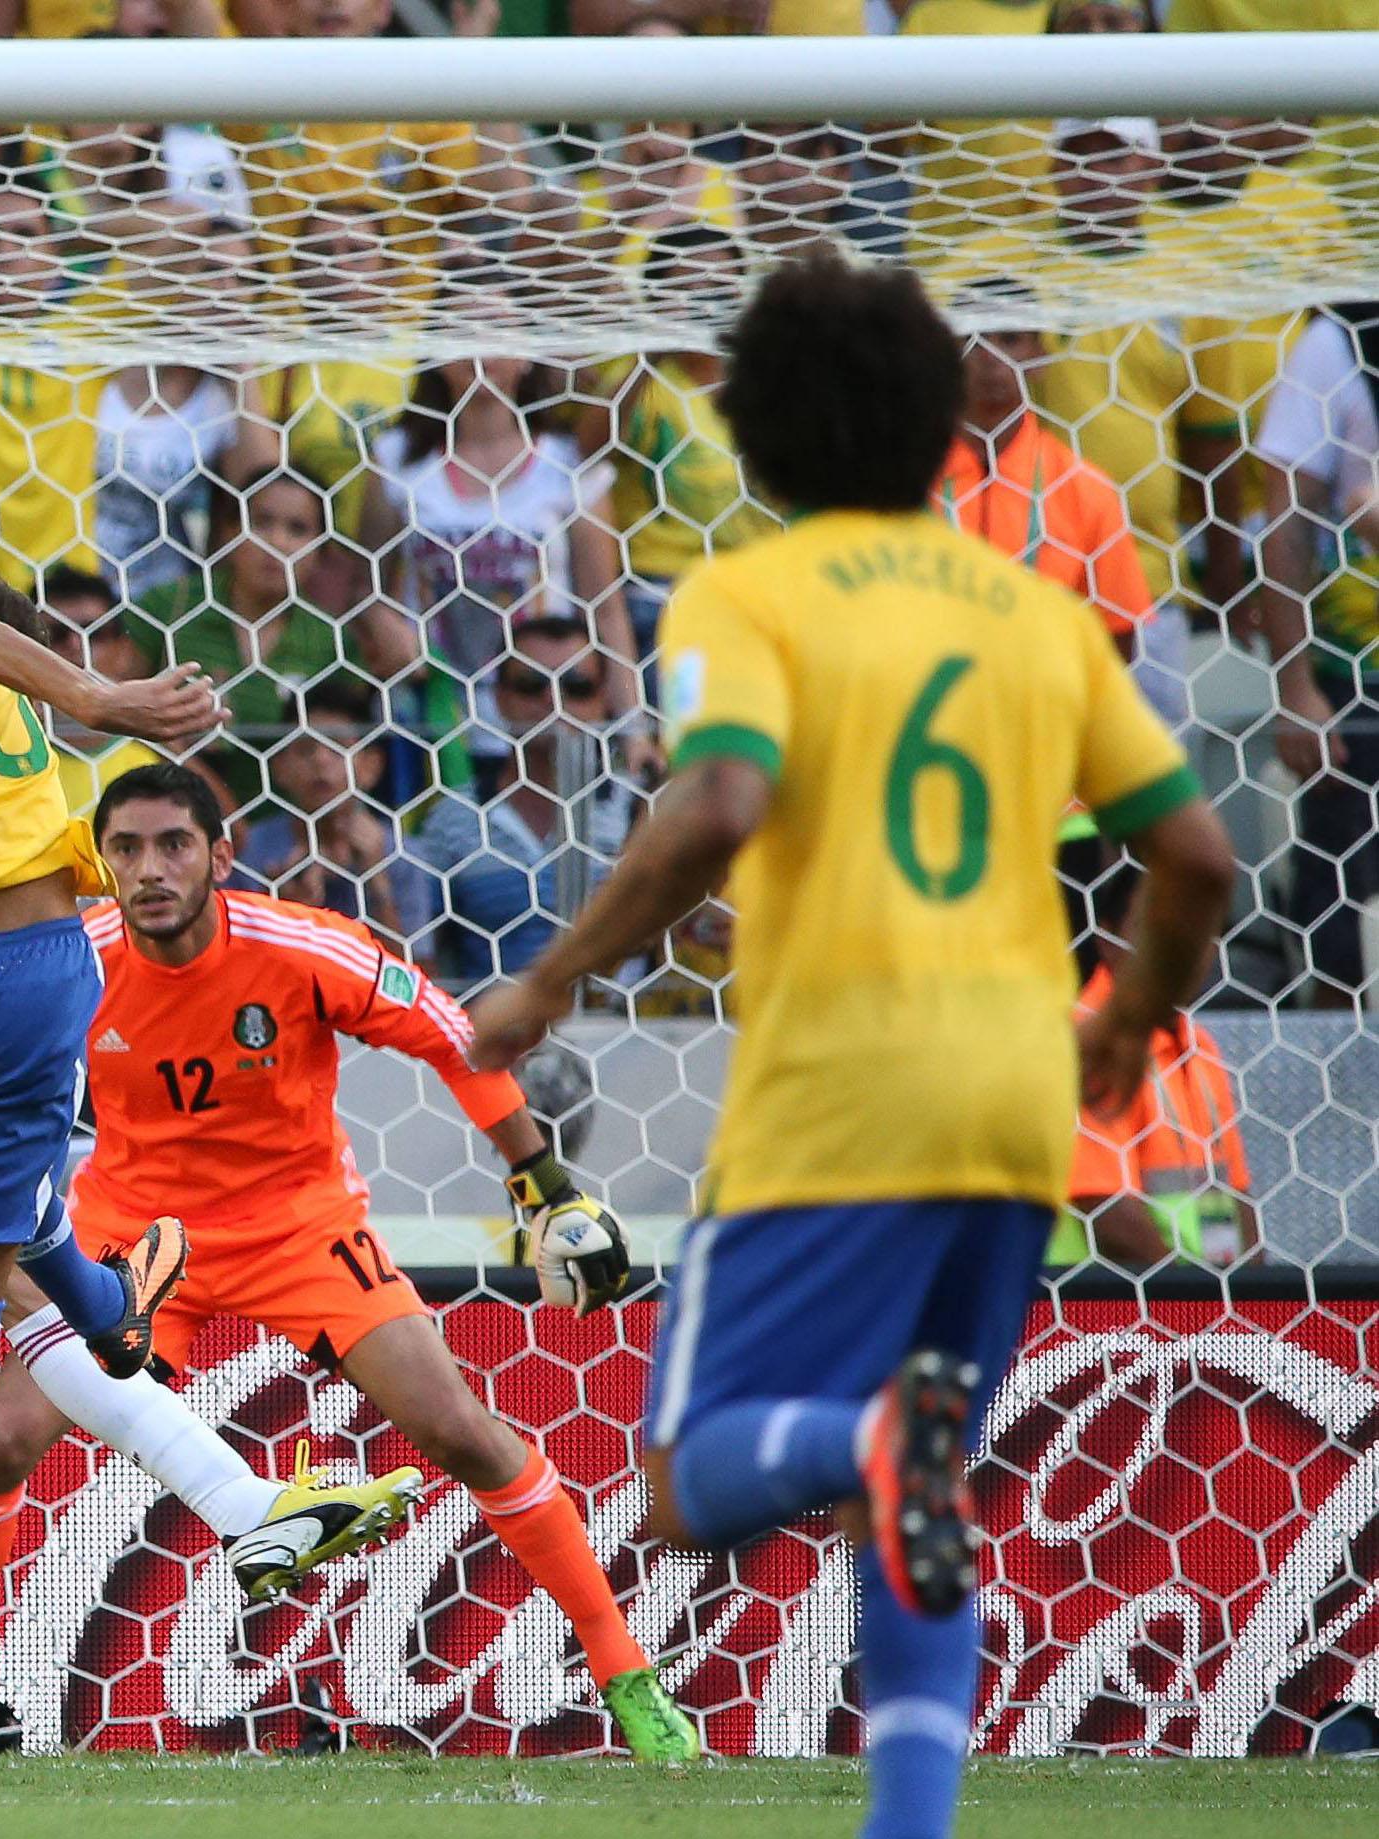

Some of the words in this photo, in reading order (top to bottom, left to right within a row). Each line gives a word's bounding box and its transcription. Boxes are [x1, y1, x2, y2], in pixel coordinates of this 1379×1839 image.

[820, 543, 1017, 617] MARCELO
[884, 654, 990, 900] 6
[156, 1057, 220, 1114] 12
[330, 1230, 399, 1292] 12
